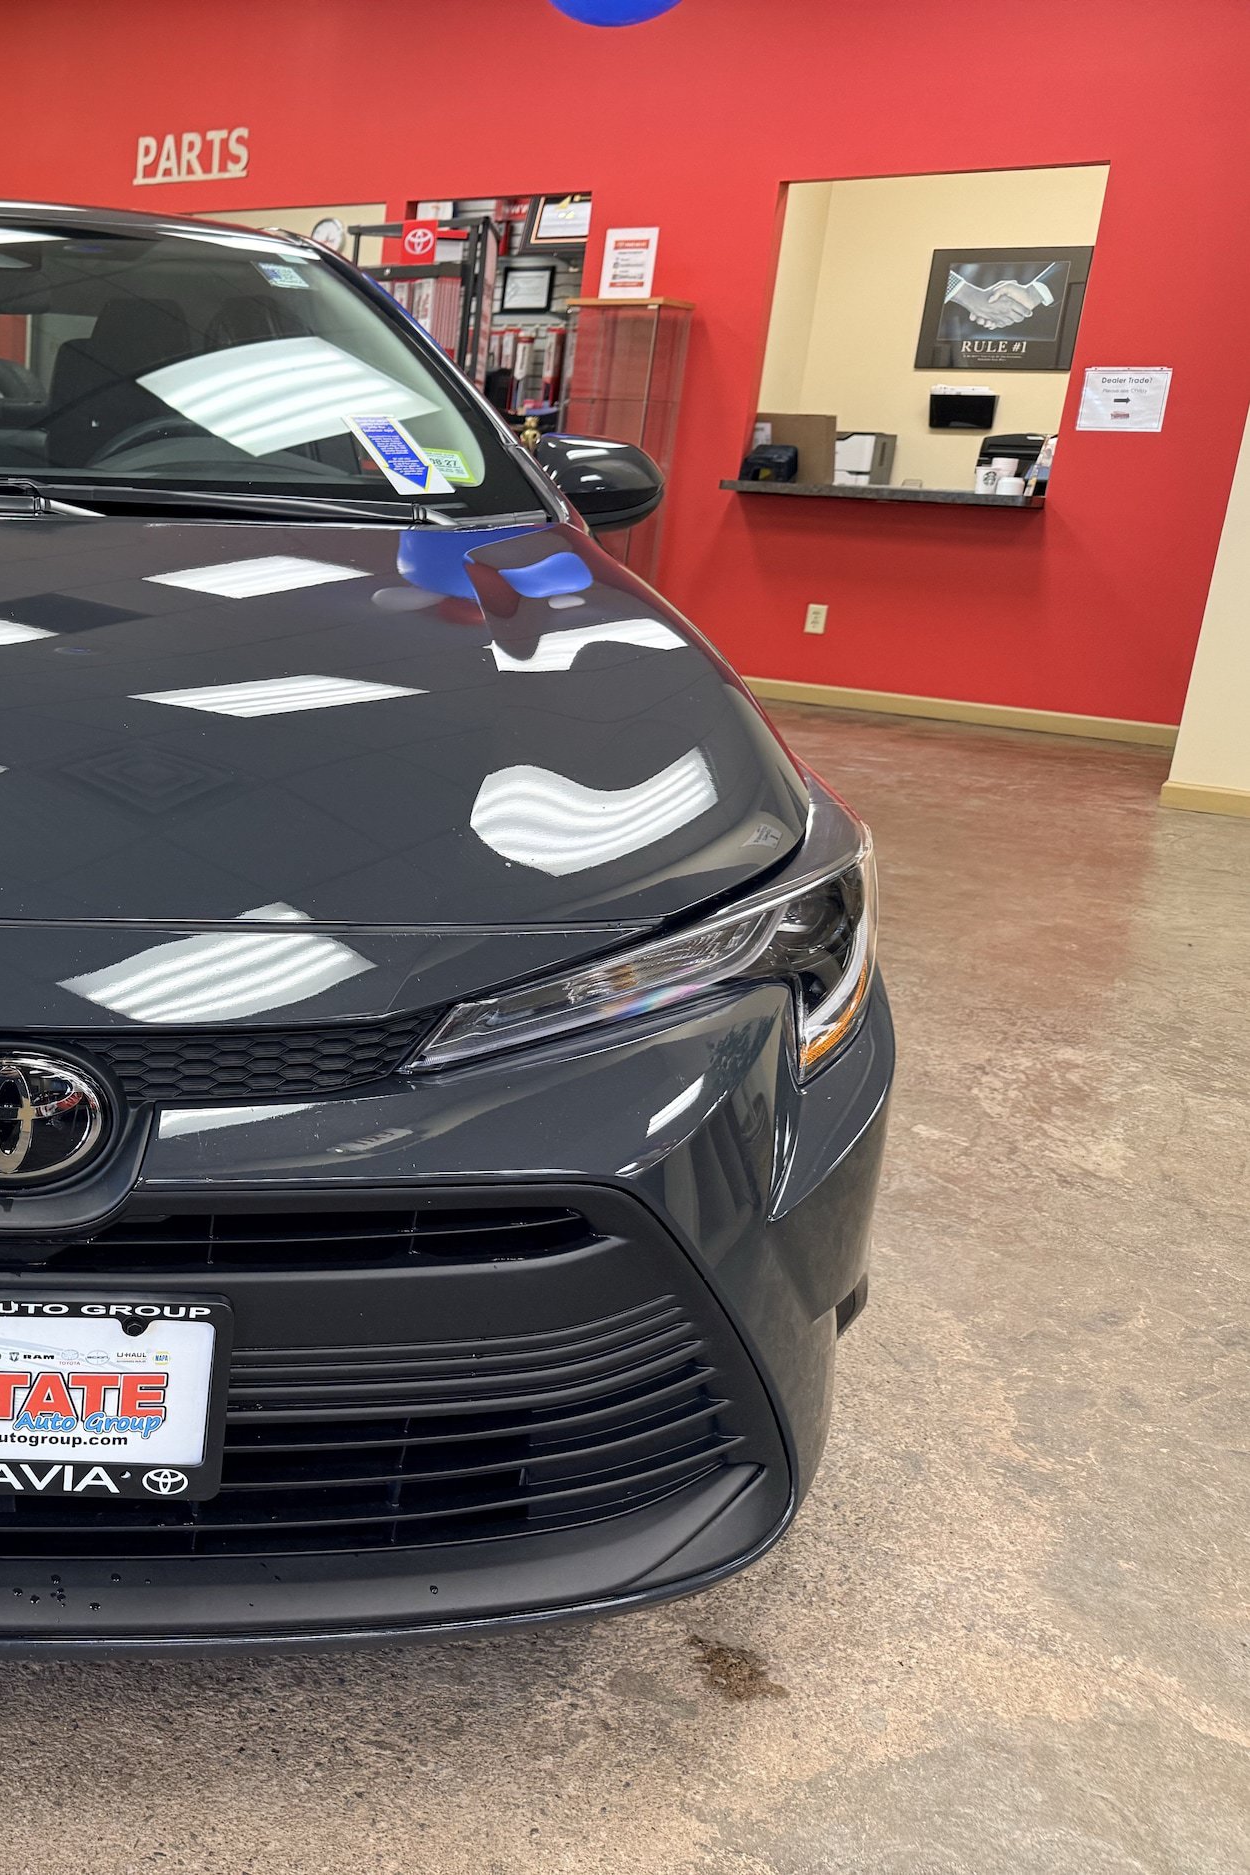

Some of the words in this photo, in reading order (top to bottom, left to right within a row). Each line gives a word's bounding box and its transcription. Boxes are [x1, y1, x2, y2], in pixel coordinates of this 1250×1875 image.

[134, 127, 249, 182] PARTS
[961, 340, 1008, 353] RULE
[1012, 341, 1027, 353] #1
[81, 1303, 211, 1319] GROUP
[13, 1411, 76, 1433] Auto
[83, 1412, 163, 1439] Group
